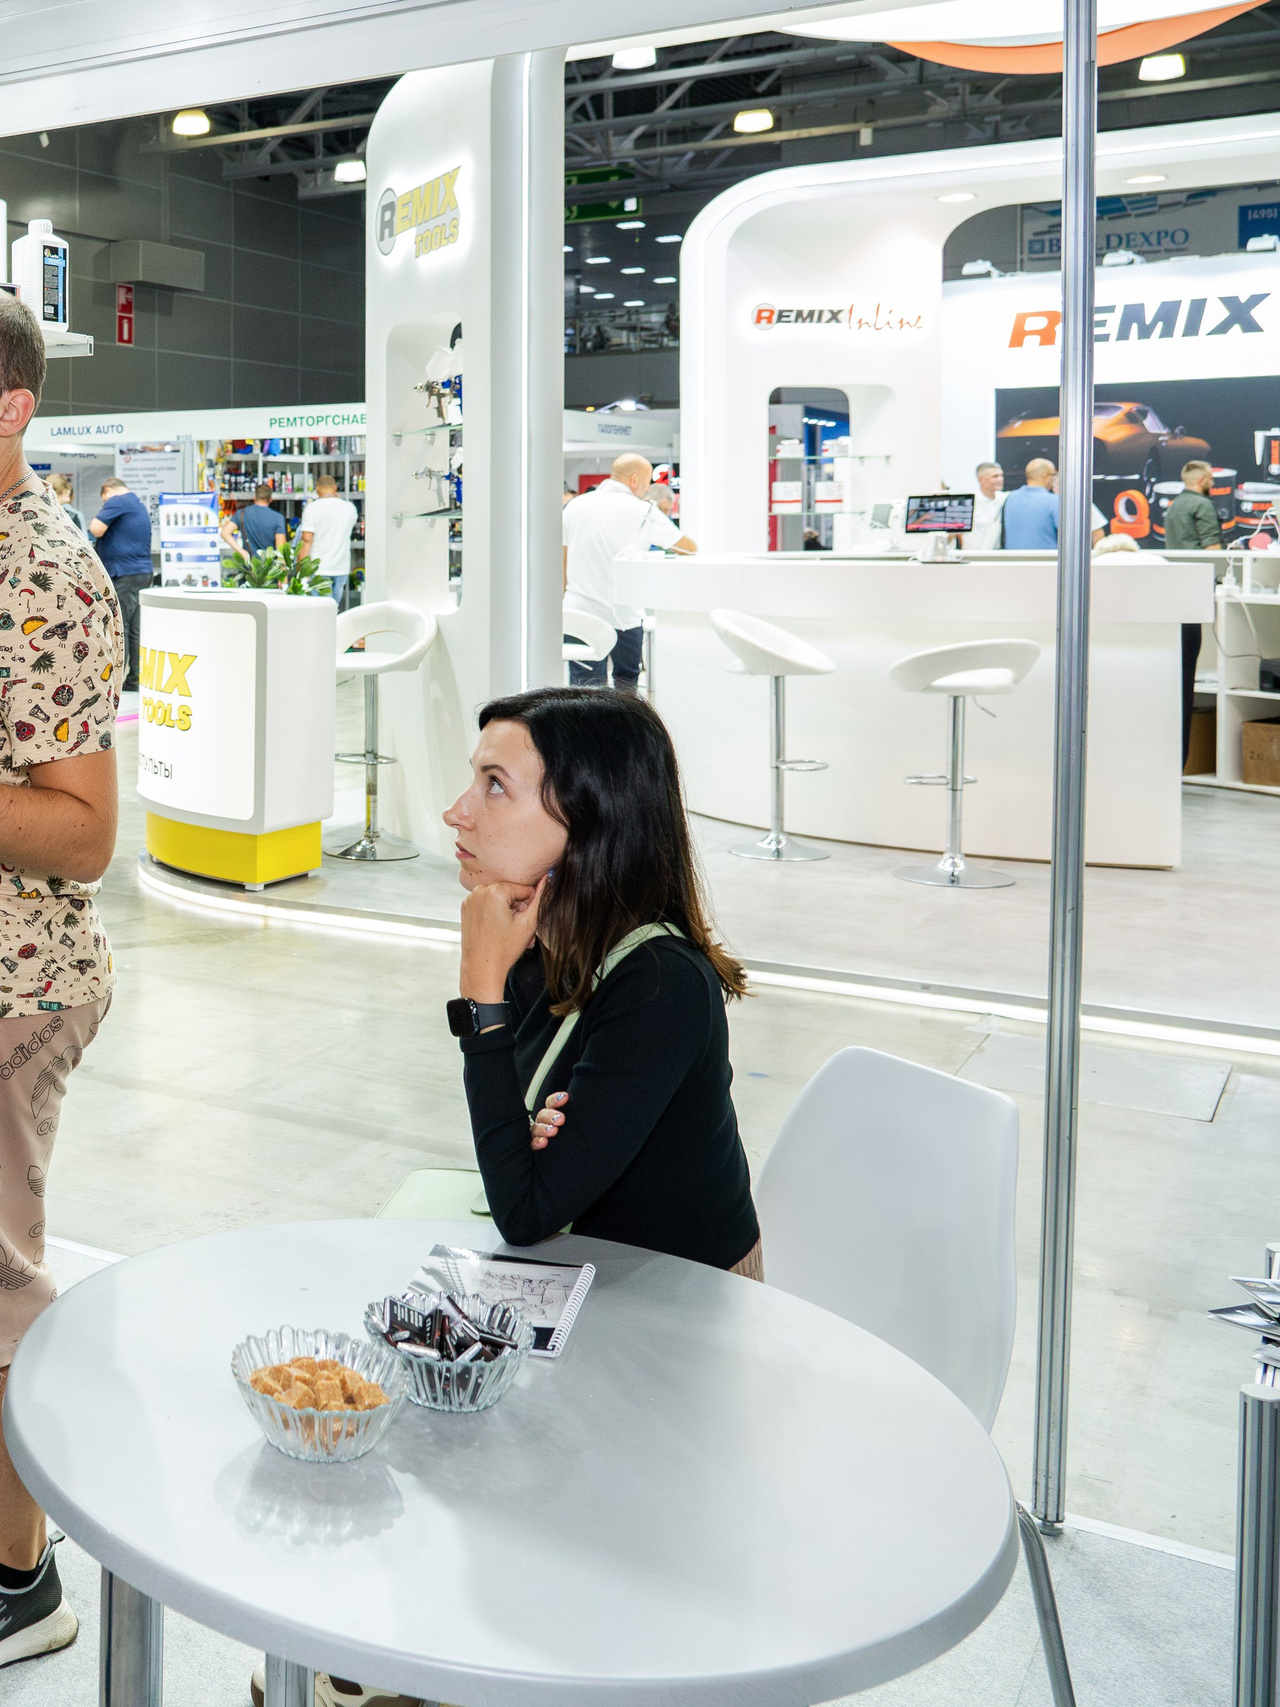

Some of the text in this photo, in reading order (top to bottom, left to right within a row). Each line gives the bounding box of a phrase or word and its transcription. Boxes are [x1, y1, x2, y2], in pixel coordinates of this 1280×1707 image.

[379, 165, 461, 243] REMIX
[414, 217, 458, 258] TOOLS
[1048, 228, 1189, 254] BDEXPO
[755, 302, 923, 331] REMIX Inline
[1008, 293, 1272, 348] REMIX
[50, 424, 124, 437] LAMLUX AUTO
[139, 645, 198, 697] MIX
[142, 696, 192, 732] TOOLS
